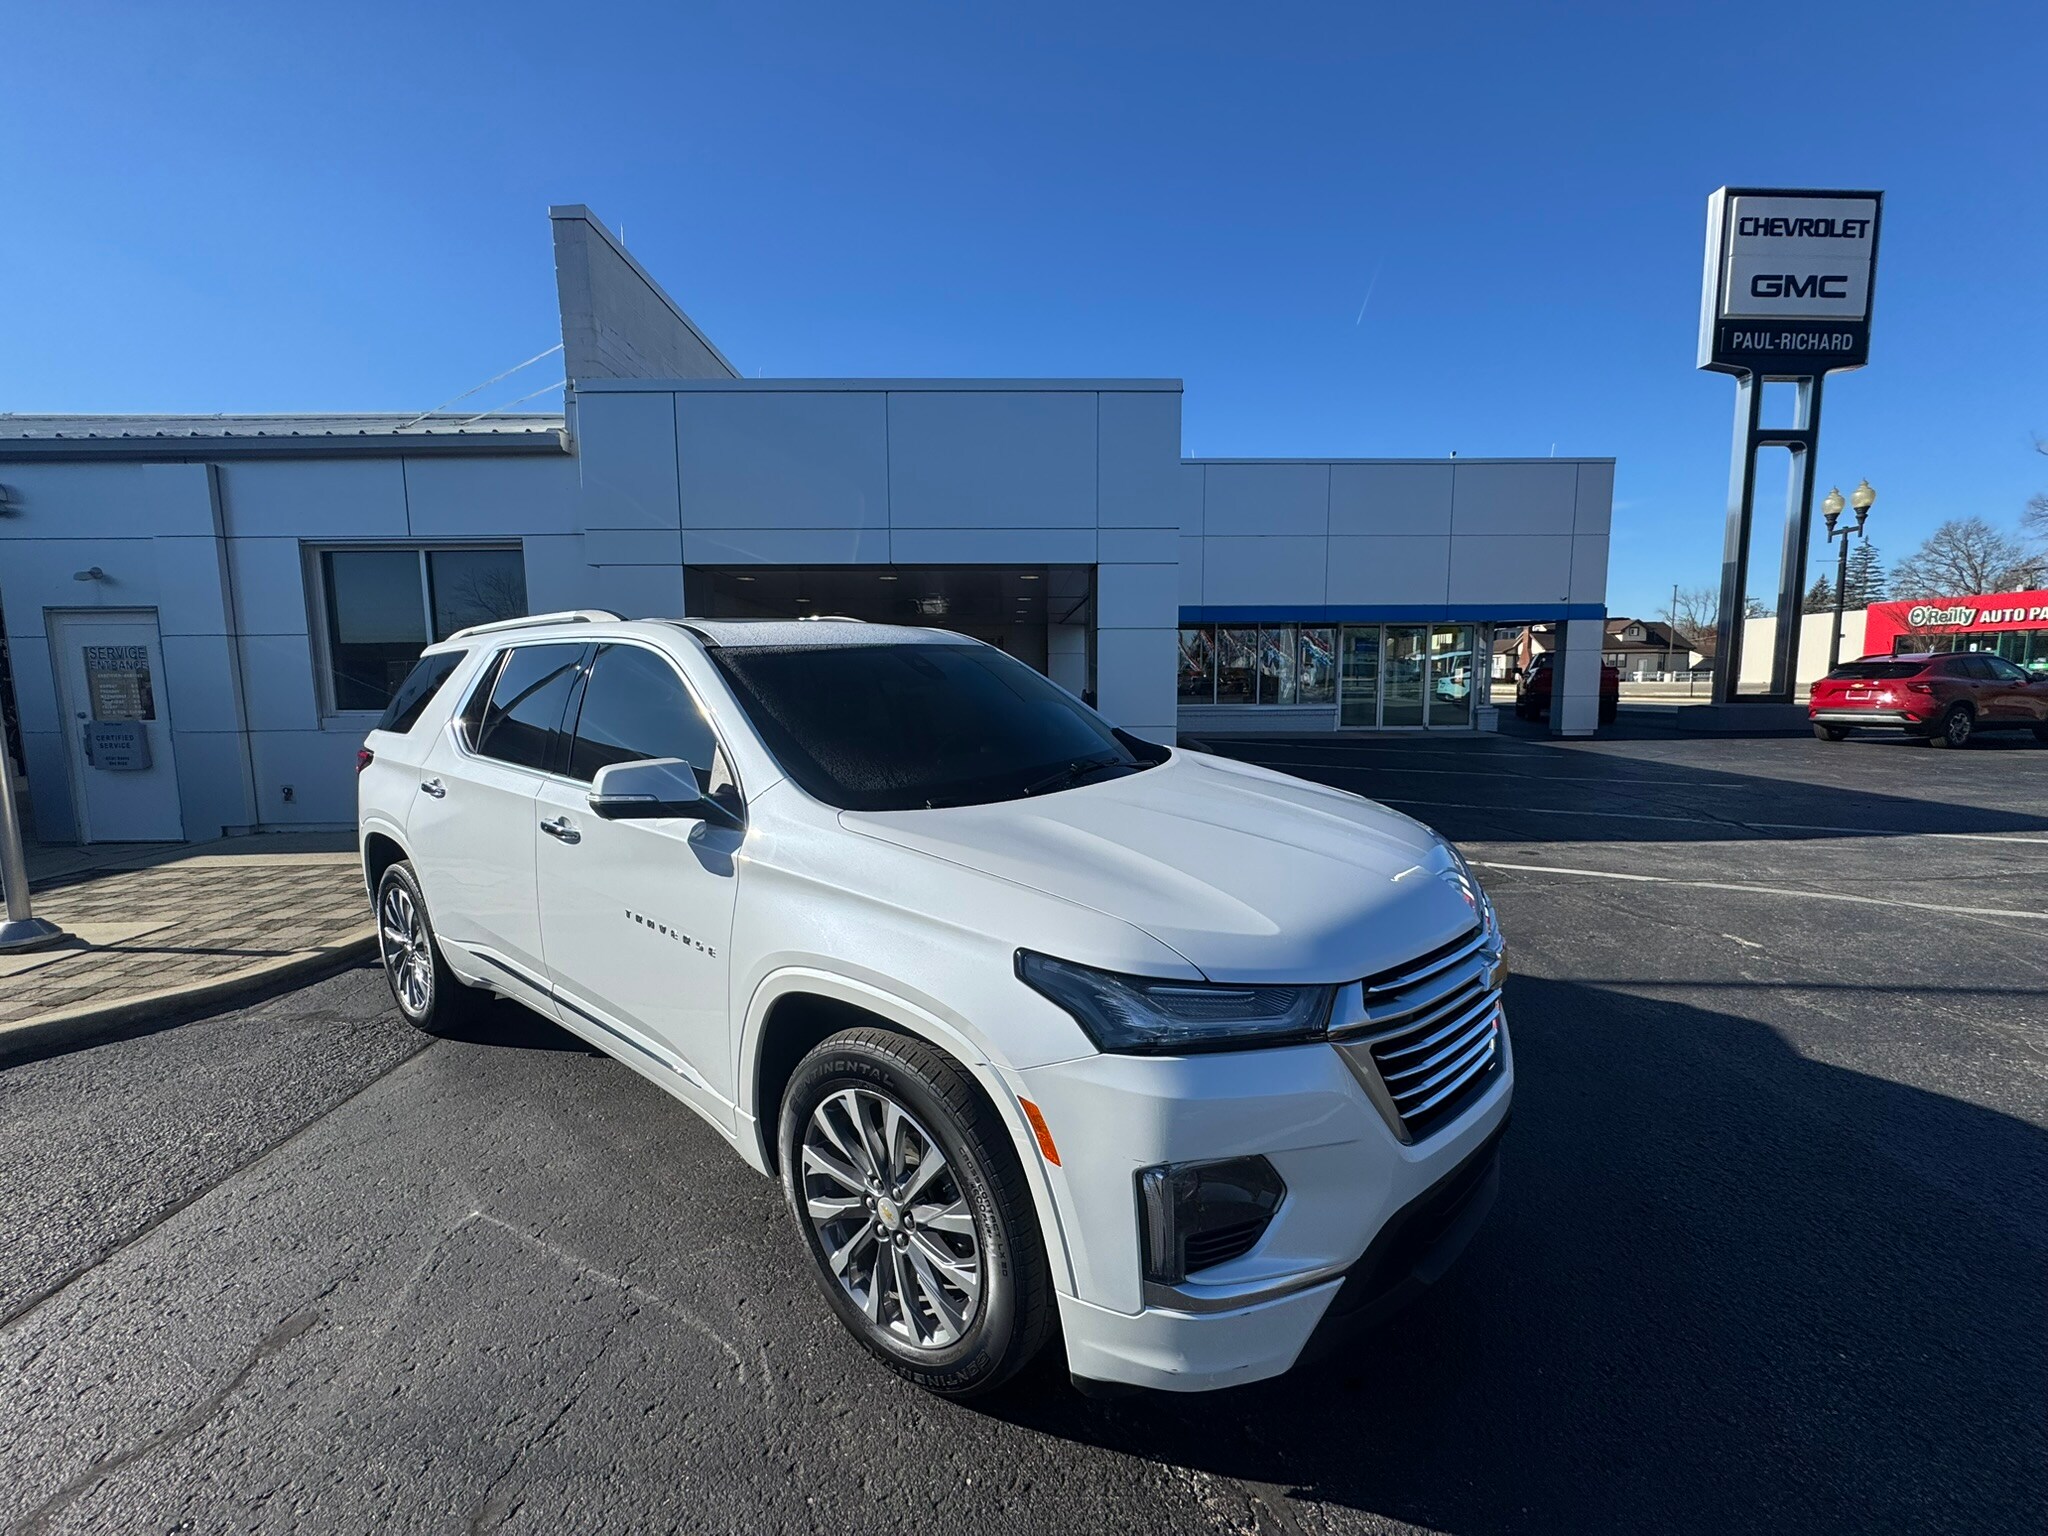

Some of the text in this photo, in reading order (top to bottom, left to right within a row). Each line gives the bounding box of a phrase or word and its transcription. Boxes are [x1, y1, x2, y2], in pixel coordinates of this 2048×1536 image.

[1739, 217, 1870, 238] CHEVROLET
[1751, 275, 1848, 298] GMC
[1732, 332, 1853, 350] PAUL-RICHARD
[1909, 606, 1975, 626] O'Reilly
[1980, 607, 2026, 623] AUTO
[89, 647, 147, 660] SERVICE
[90, 660, 149, 670] ENTRANCE
[96, 734, 135, 742] CERTIFIED
[625, 909, 716, 958] TRAVERSE
[789, 1060, 895, 1114] CONTINENTAL
